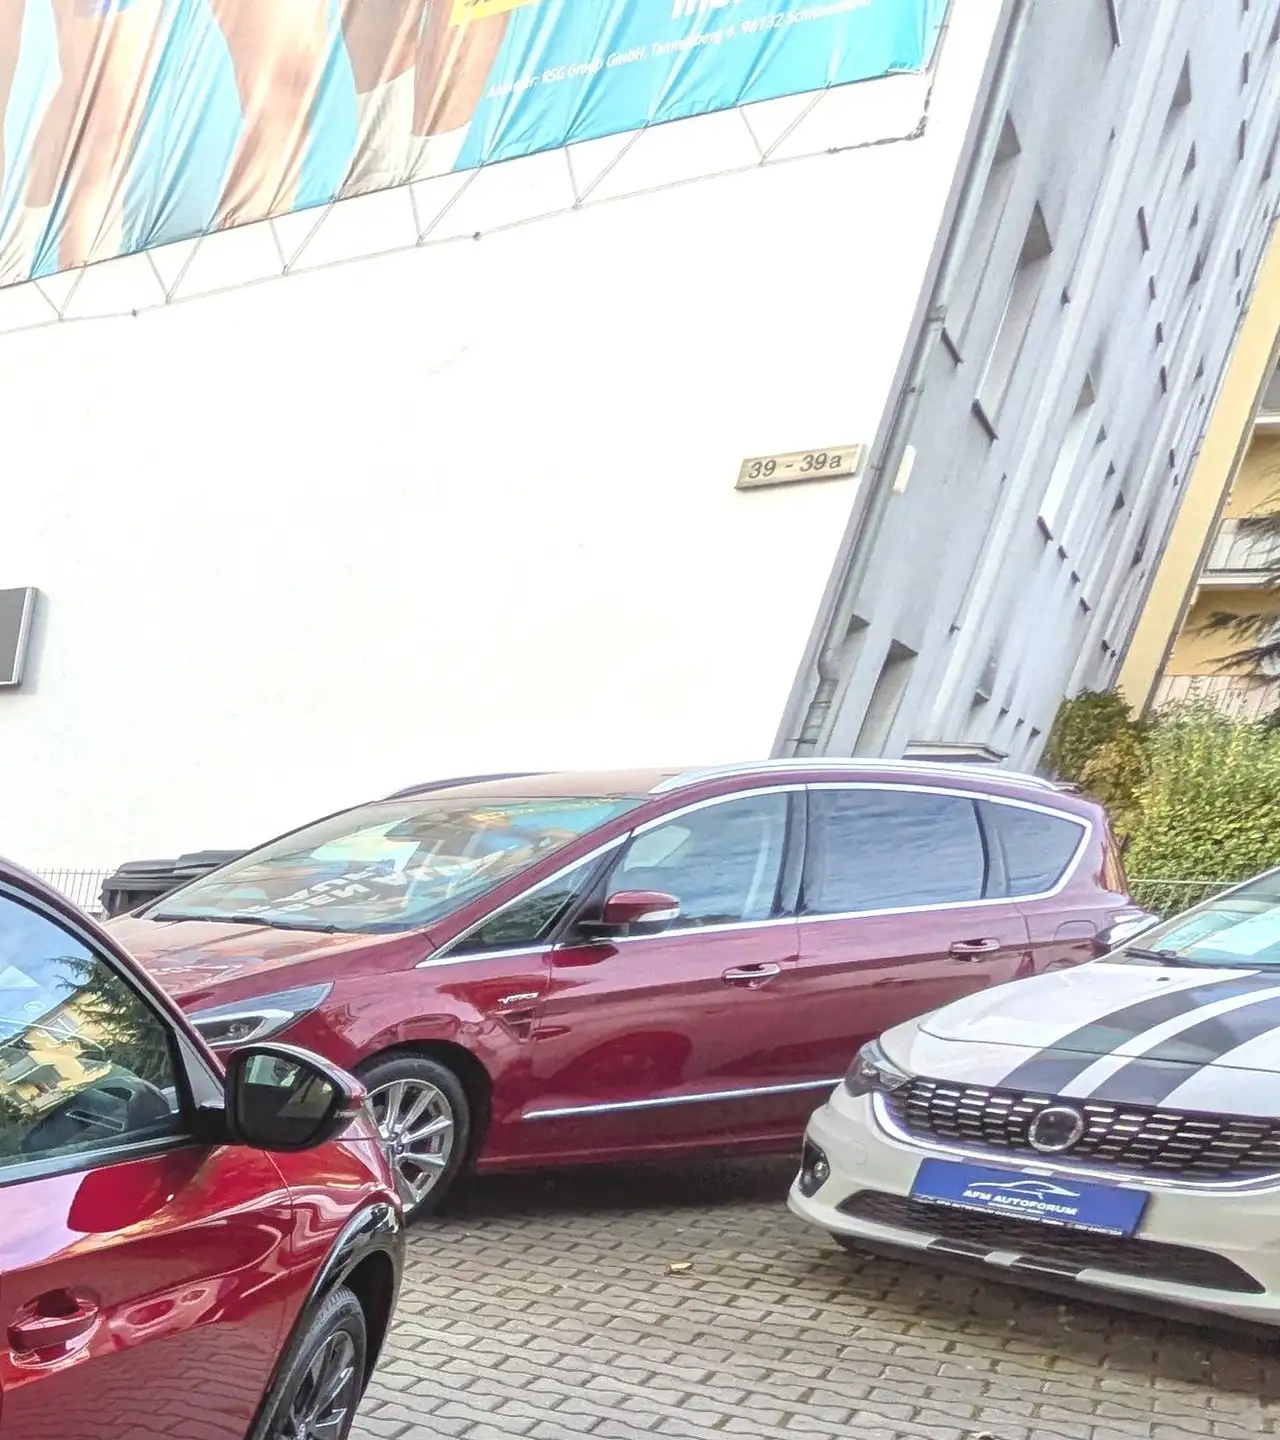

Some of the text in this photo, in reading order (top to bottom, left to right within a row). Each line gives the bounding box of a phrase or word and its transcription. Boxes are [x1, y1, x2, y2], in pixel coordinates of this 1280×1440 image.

[747, 460, 776, 479] 39
[800, 453, 842, 472] 39a
[994, 1194, 1080, 1215] AUTOFORUM
